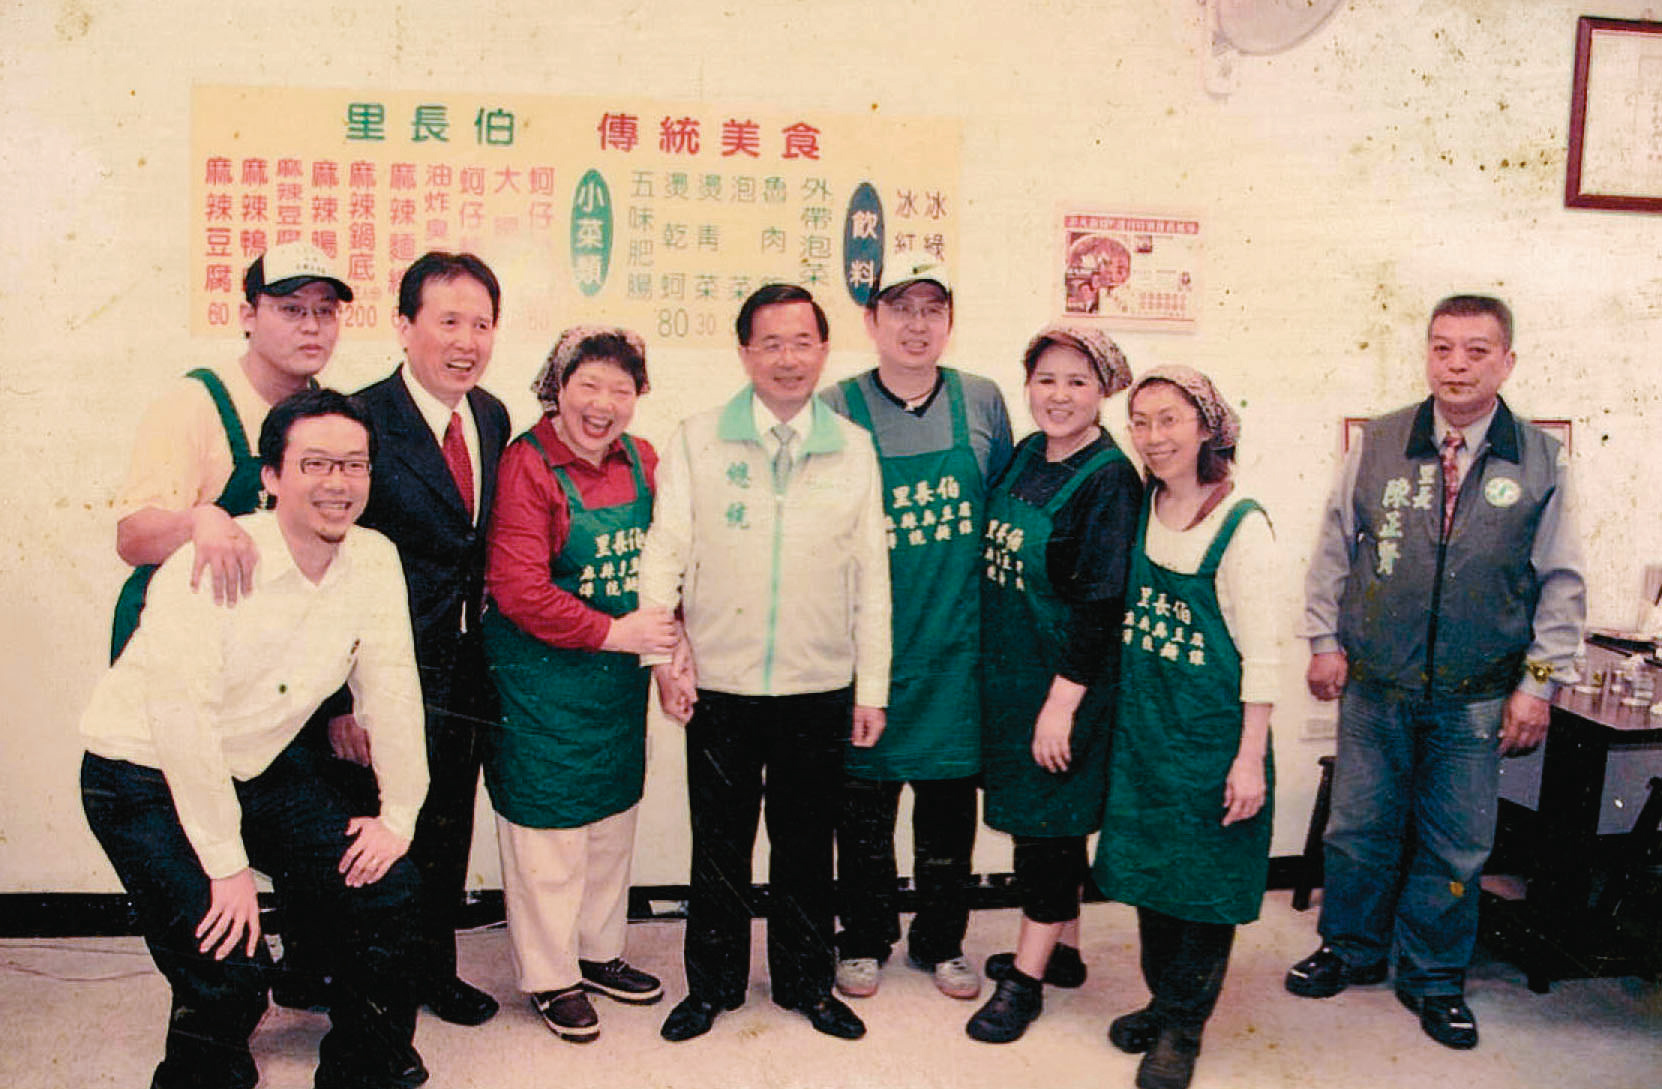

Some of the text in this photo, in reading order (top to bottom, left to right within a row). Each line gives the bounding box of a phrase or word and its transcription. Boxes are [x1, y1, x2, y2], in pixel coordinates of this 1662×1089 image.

[345, 102, 822, 160] 里長伯 傳統美食
[205, 156, 233, 293] 麻辣豆腐
[348, 160, 377, 282] 麻辣鍋底
[626, 170, 655, 298] 五味肥腸
[694, 173, 724, 299] 燙青菜
[800, 176, 834, 287] 外帶泡菜
[850, 209, 878, 287] 飲料
[345, 306, 377, 328] 200
[657, 308, 689, 338] 80
[893, 475, 960, 508] 里長伯
[1136, 586, 1192, 625] 里長伯
